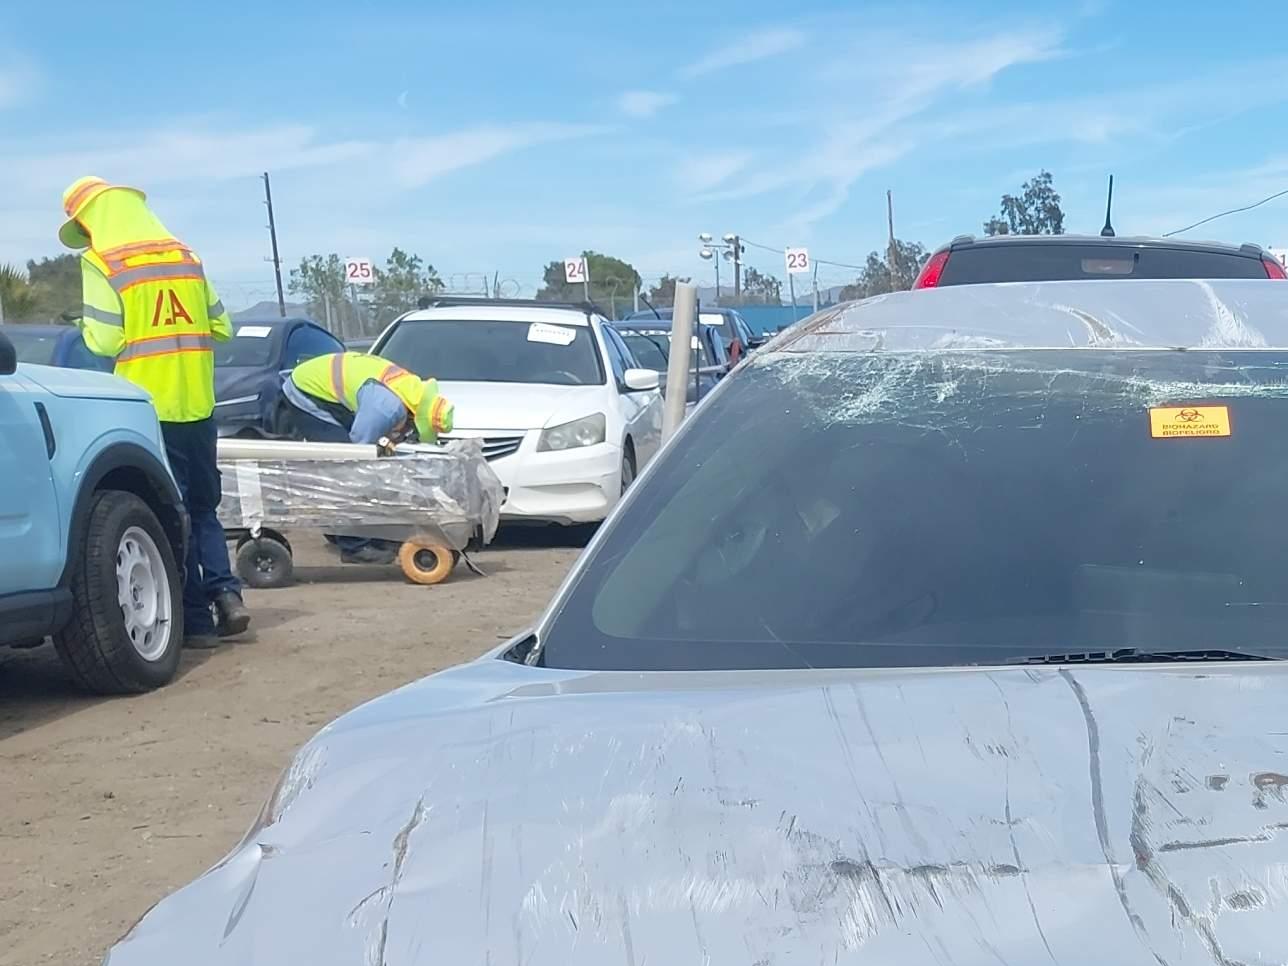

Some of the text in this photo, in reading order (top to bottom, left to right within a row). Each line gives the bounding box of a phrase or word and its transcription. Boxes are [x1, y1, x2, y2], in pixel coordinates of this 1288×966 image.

[788, 253, 807, 268] 23
[348, 262, 370, 277] 25
[567, 262, 584, 277] 24
